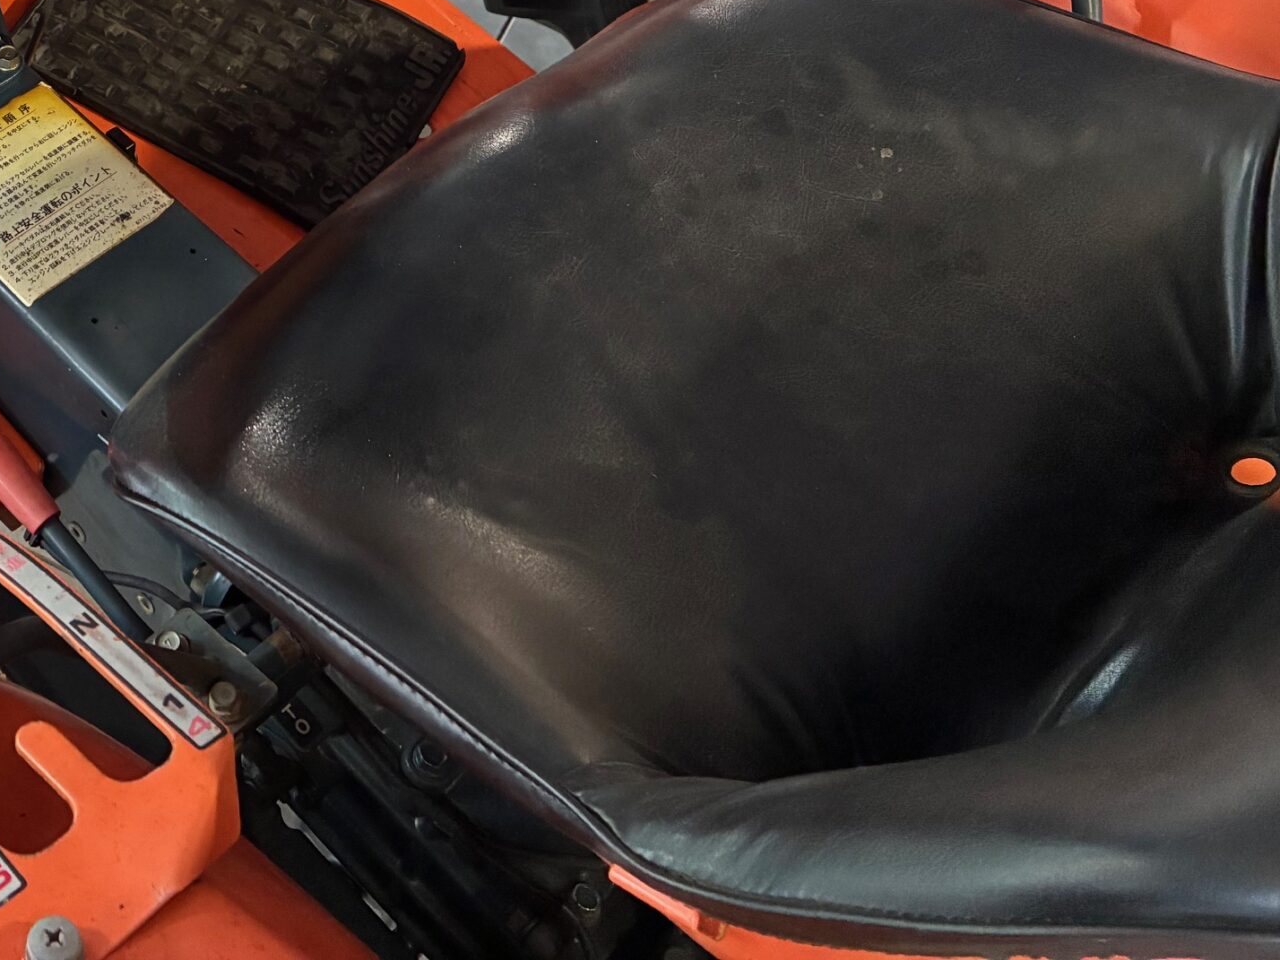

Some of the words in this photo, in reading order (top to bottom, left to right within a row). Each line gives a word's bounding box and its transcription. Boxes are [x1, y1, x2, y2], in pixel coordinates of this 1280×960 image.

[69, 612, 100, 636] N
[162, 692, 185, 709] 1
[188, 714, 211, 736] 4
